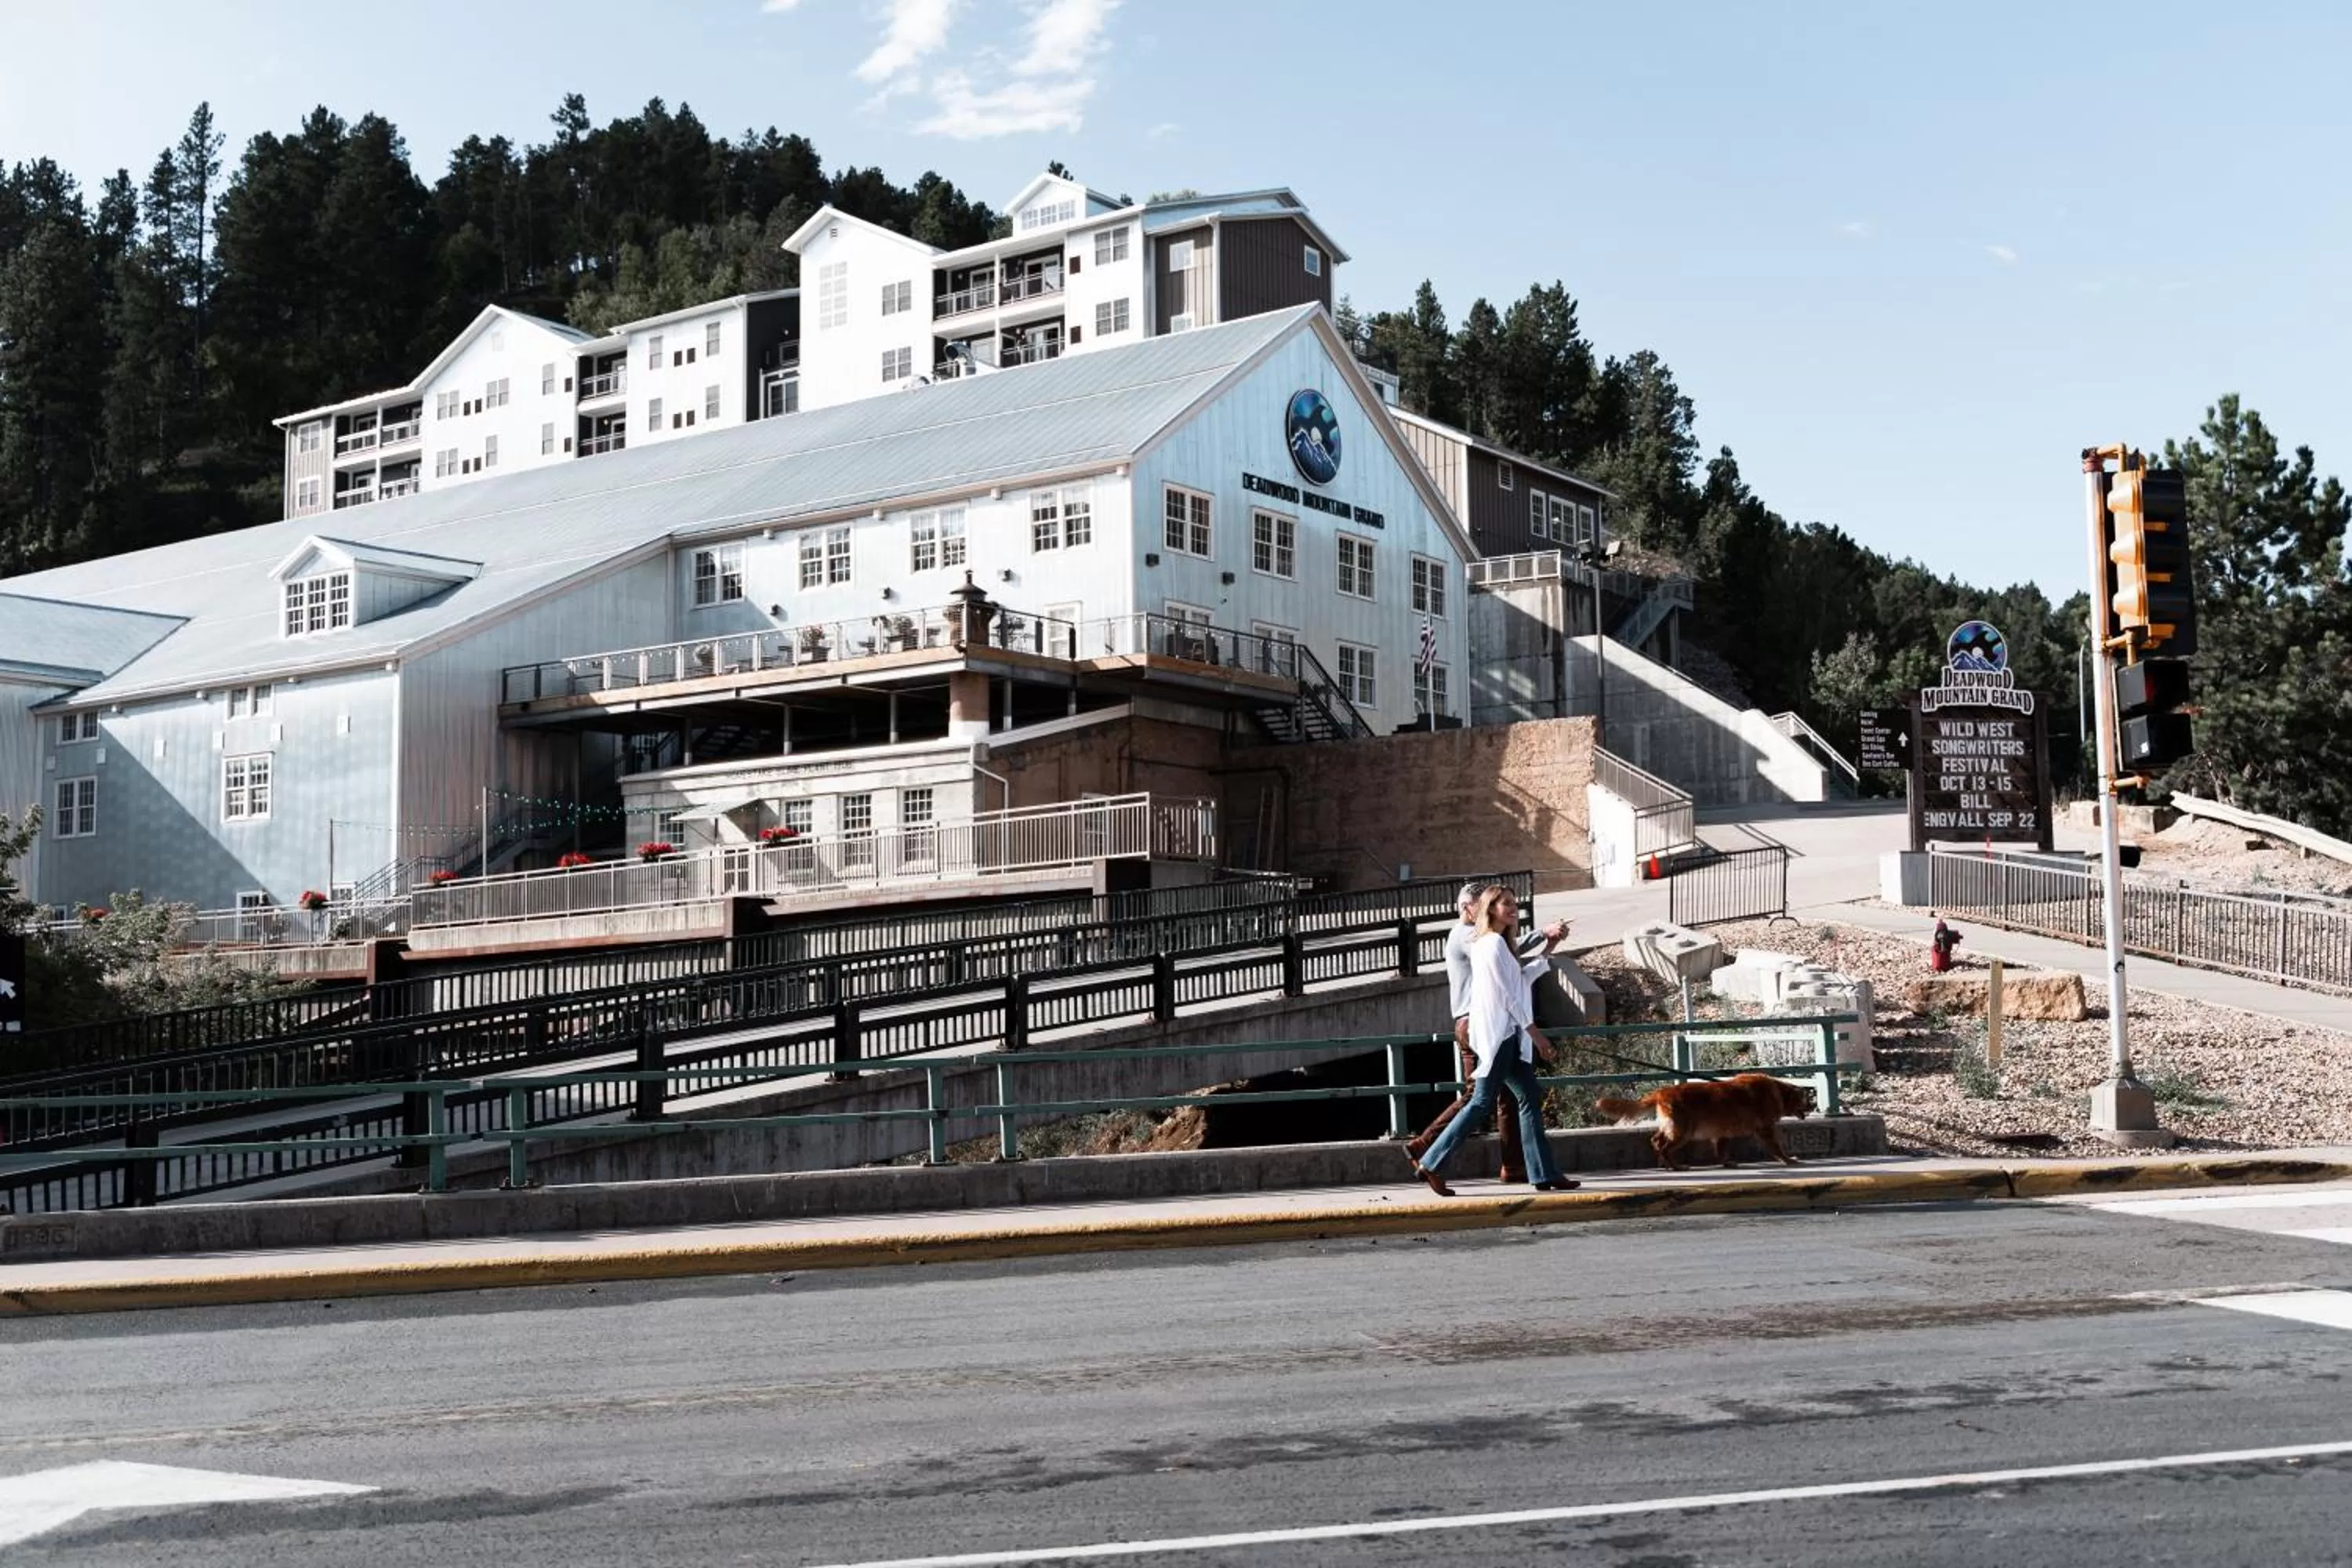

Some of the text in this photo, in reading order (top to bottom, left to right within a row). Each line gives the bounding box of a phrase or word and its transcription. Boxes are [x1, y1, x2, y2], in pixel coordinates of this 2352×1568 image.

[1242, 472, 1385, 530] DEADWOOD MOUNTAIN GRAND
[1944, 668, 2012, 689] DEADWOOD
[1923, 688, 2032, 712] MOUNTAIN GRAND
[1939, 722, 2015, 737] WILD WEST
[1931, 739, 2024, 755] SONGWRITERS
[1942, 758, 2009, 772] FESTIVAL
[1940, 775, 1966, 791] OCT
[1961, 794, 1992, 808] BILL
[1924, 812, 2036, 827] ENGVALL SEP 22
